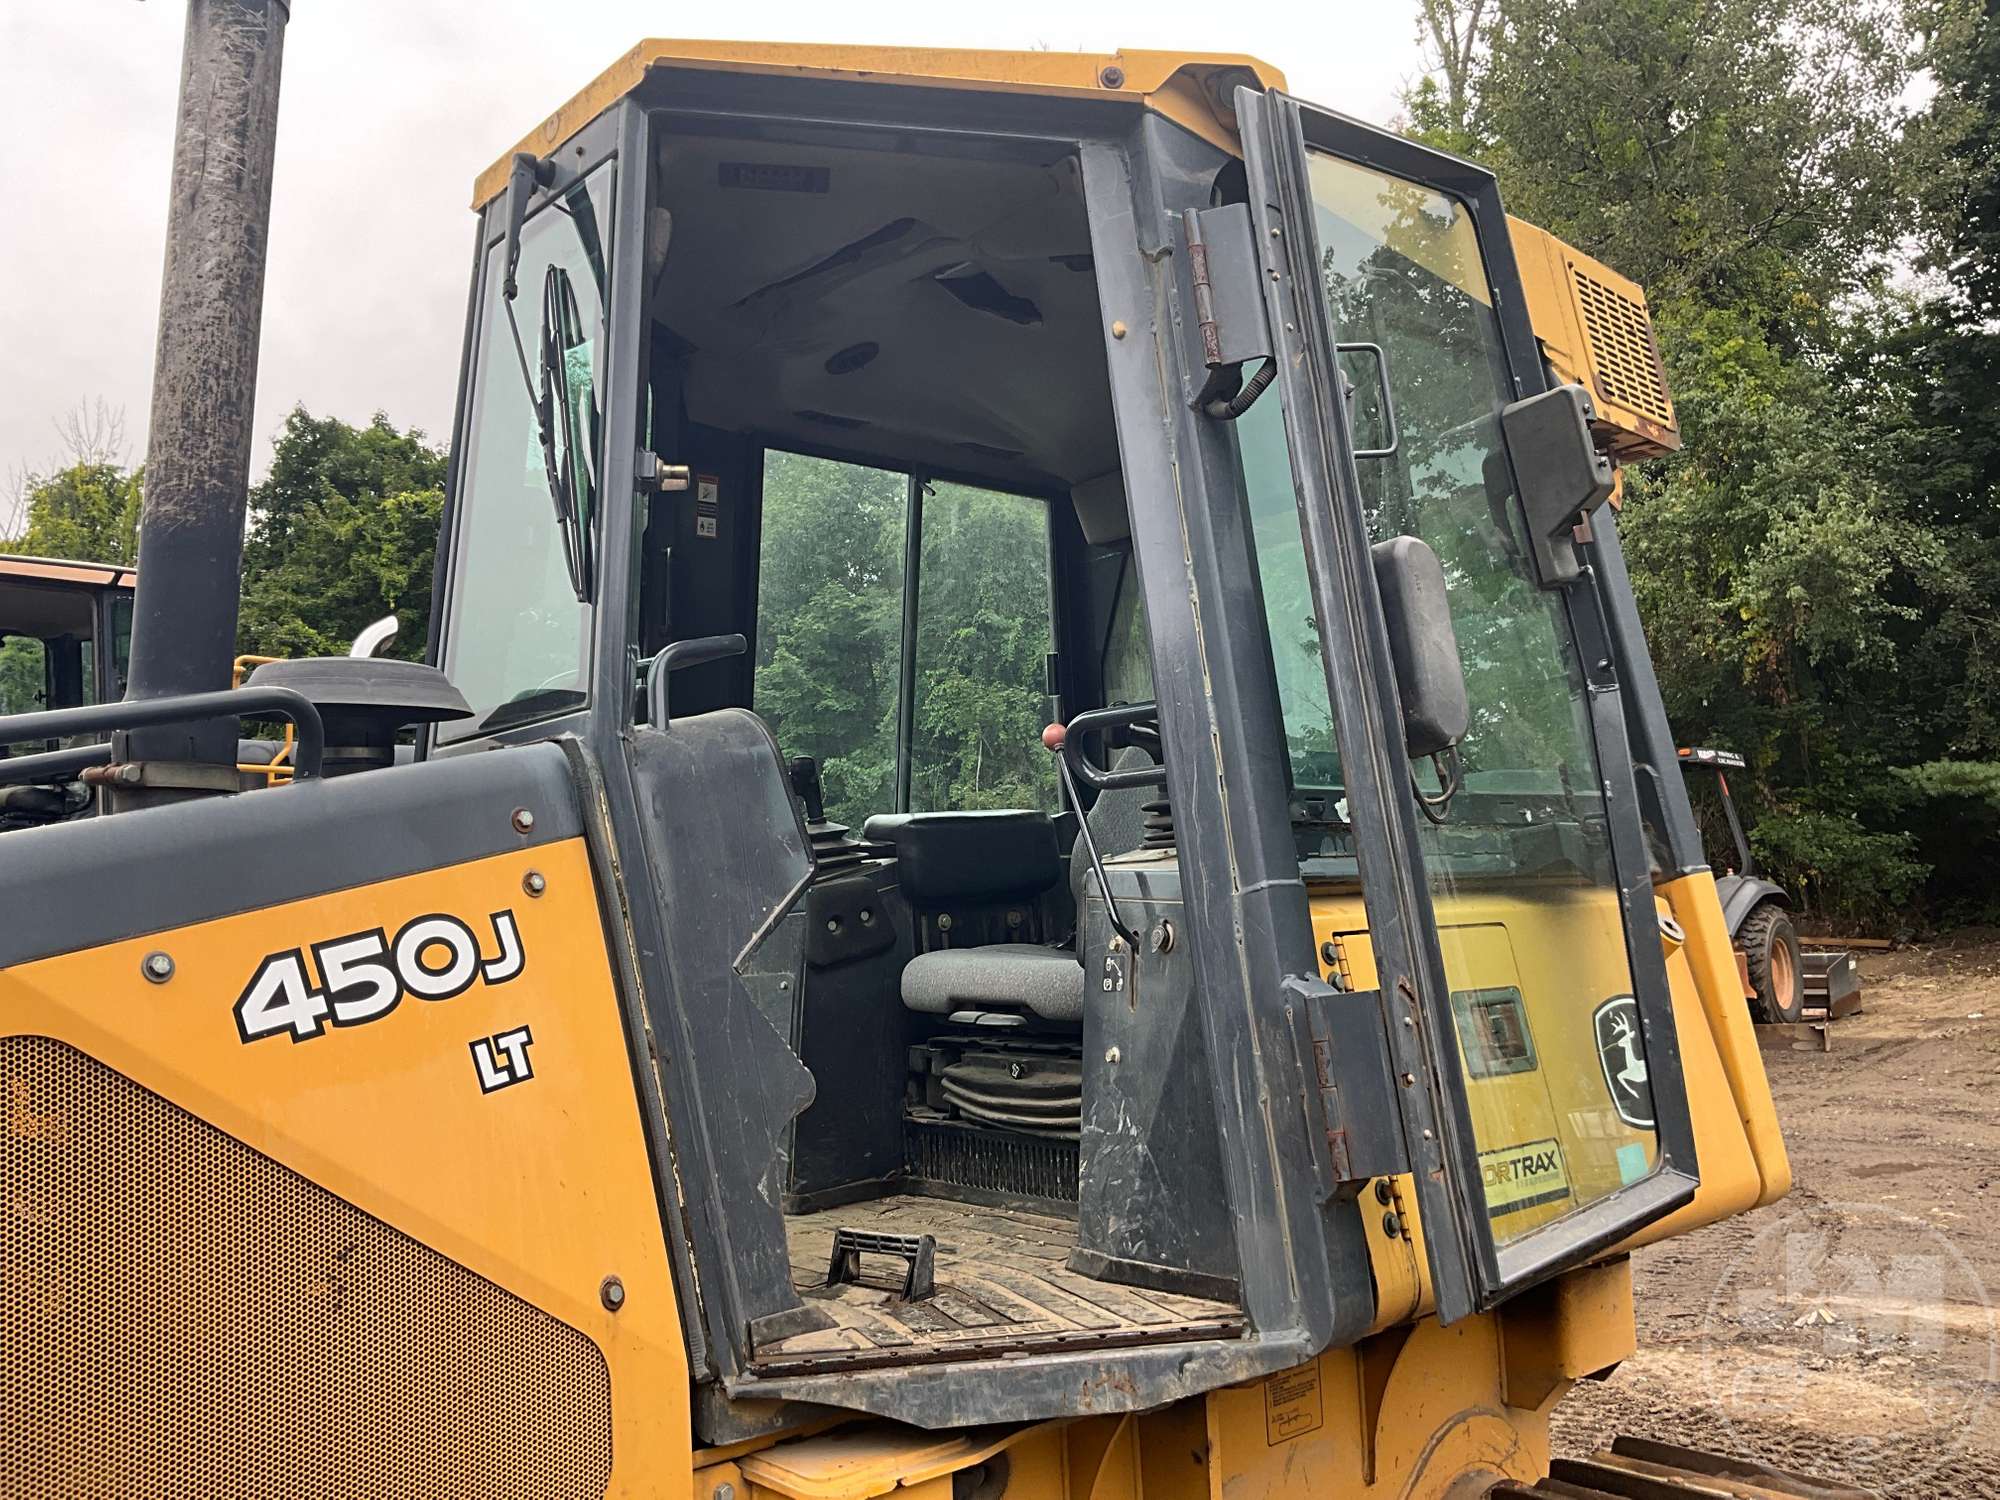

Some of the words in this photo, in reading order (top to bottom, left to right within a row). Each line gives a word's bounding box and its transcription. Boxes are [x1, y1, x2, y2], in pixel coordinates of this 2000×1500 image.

[233, 908, 526, 1044] 450J
[469, 1025, 534, 1095] LT
[1481, 1150, 1558, 1187] ORTRAX
